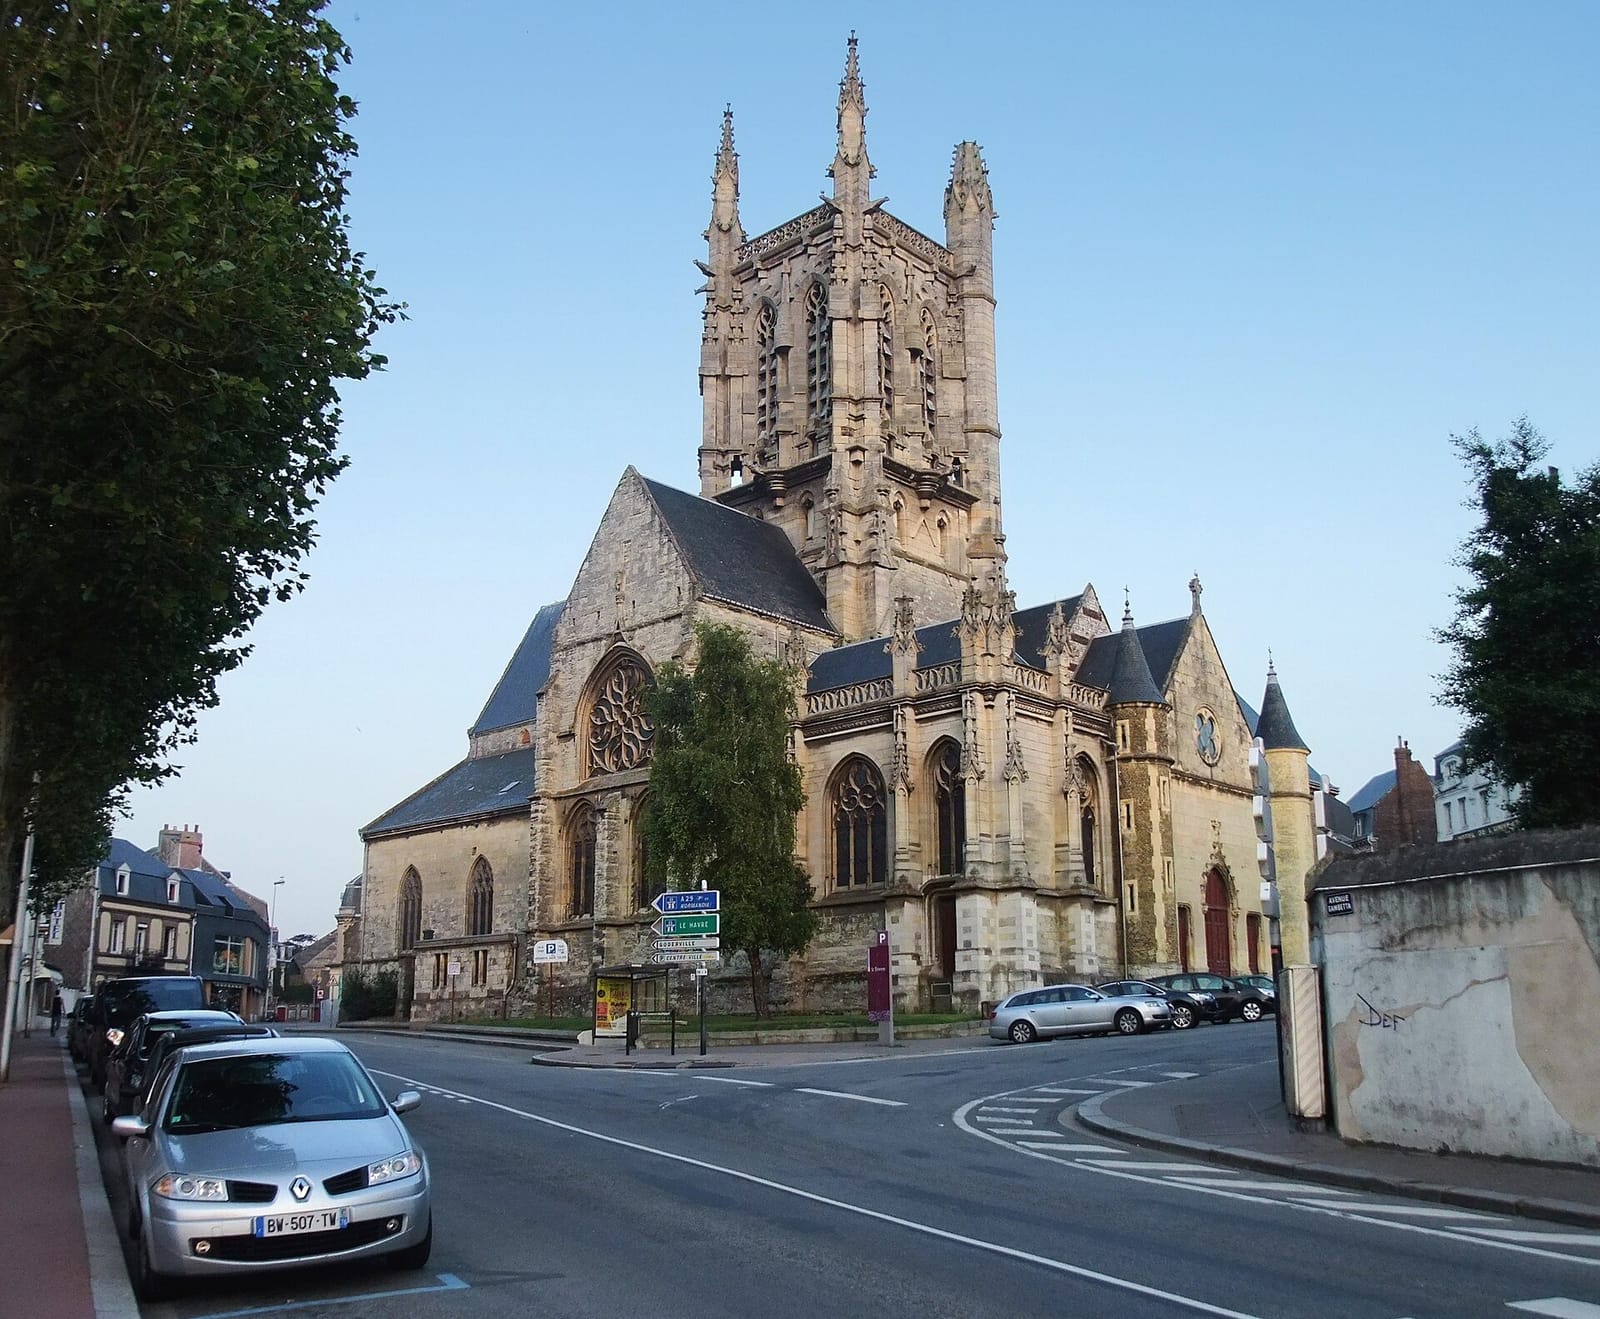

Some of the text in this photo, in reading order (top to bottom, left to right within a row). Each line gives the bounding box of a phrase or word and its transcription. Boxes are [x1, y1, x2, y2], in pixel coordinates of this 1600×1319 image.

[1328, 894, 1350, 904] AVENUE
[1327, 902, 1352, 912] GAMBETTA
[879, 933, 886, 944] P
[547, 945, 554, 954] P
